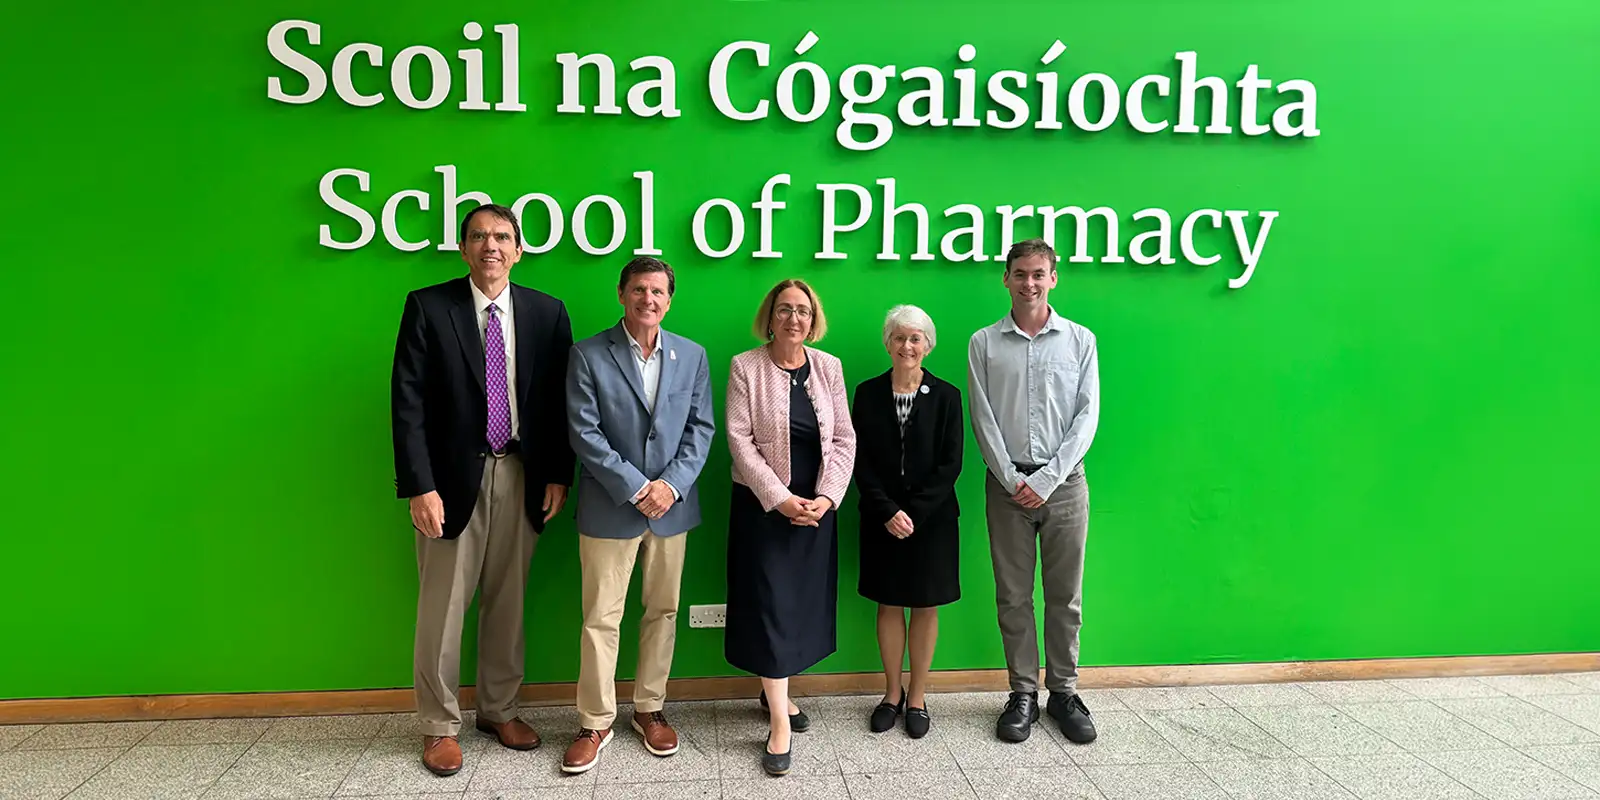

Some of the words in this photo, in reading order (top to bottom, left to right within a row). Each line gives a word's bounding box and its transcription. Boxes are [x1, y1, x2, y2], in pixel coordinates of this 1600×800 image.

[267, 19, 527, 112] Scoil
[556, 52, 681, 118] na
[708, 30, 1321, 151] Cógaisíochta
[319, 164, 663, 256] School
[692, 173, 791, 258] of
[814, 177, 1280, 289] Pharmacy
